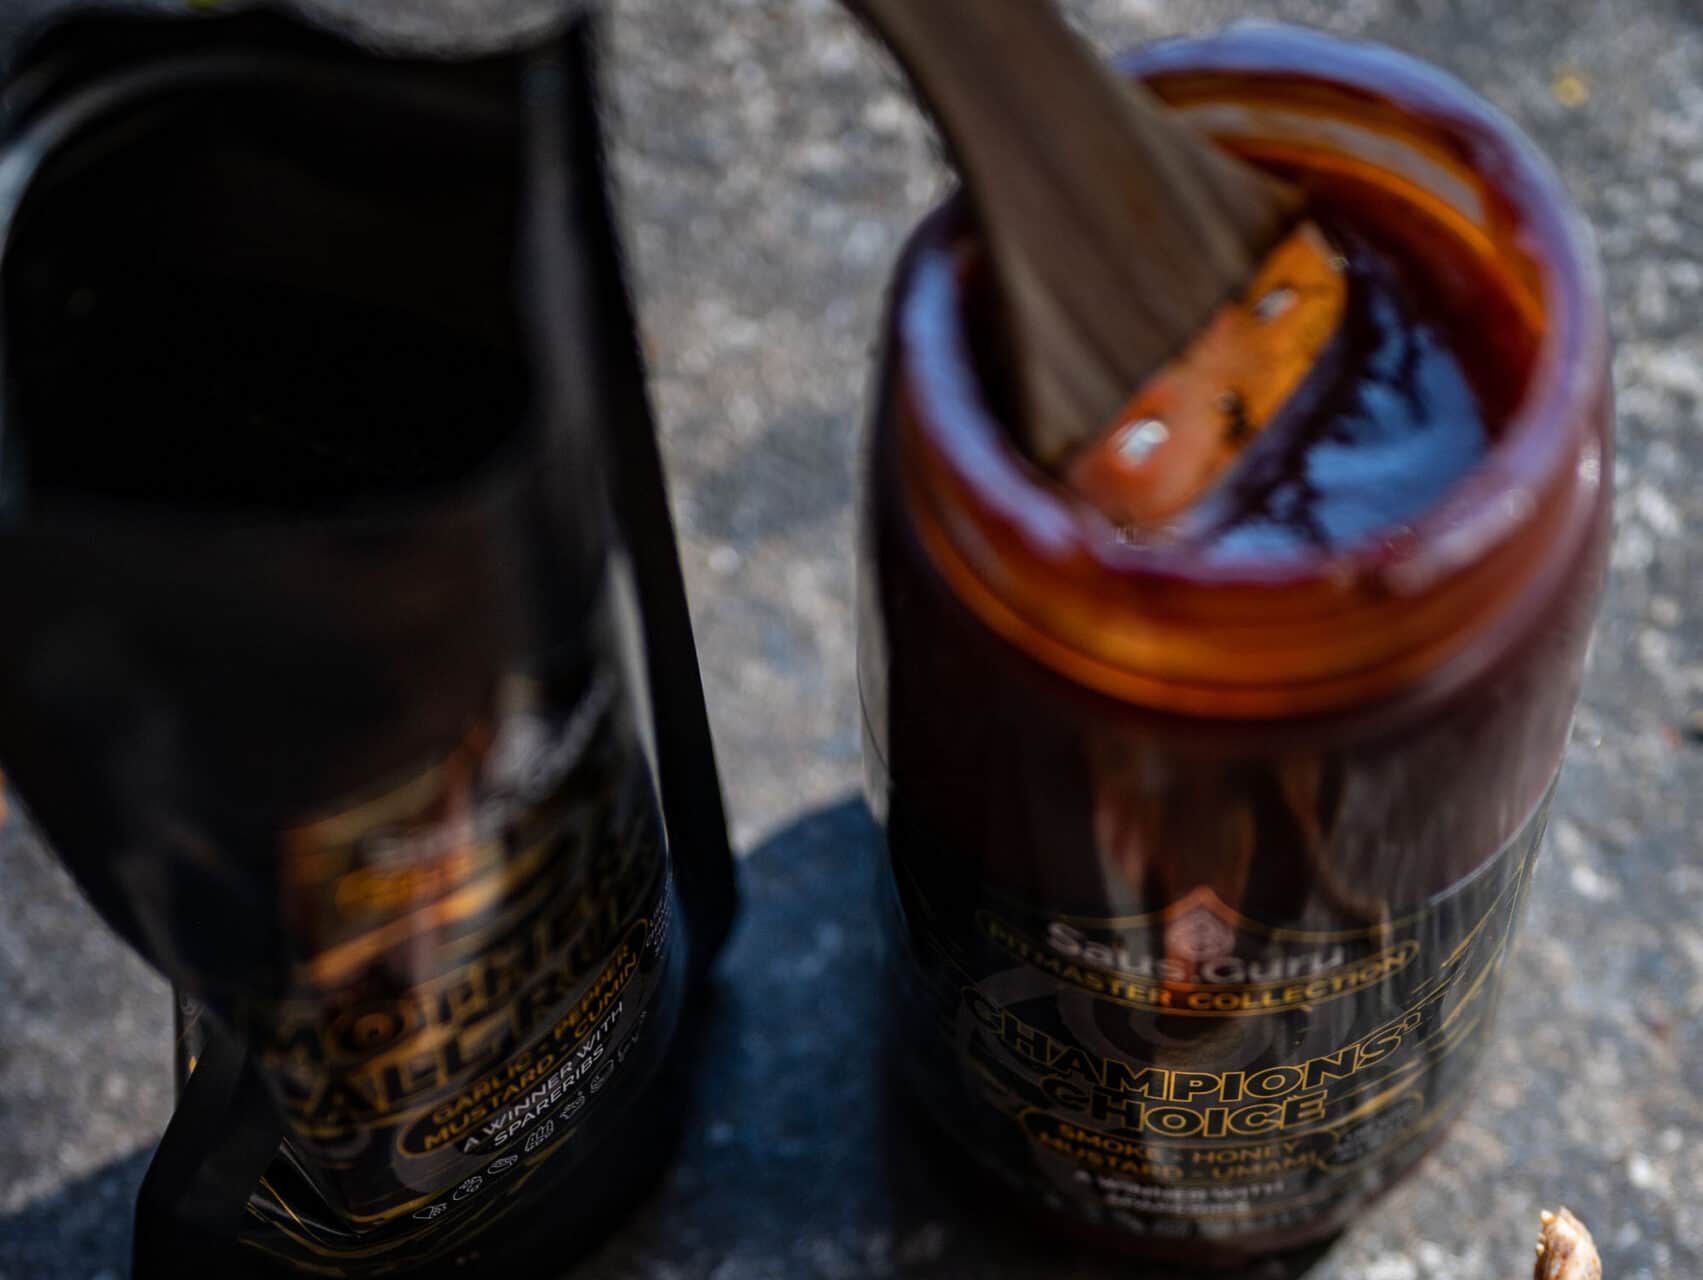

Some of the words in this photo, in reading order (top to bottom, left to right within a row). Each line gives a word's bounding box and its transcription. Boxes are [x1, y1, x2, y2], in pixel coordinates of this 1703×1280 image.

[1048, 920, 1346, 986] Saus.Guru
[1188, 951, 1411, 1011] COLLECTION
[422, 1053, 557, 1152] MUSTARD
[573, 951, 638, 1039] CUMIN
[432, 1050, 533, 1125] GARLIC
[552, 942, 632, 1040] PEPPER
[463, 1135, 482, 1154] A
[483, 1060, 573, 1136] WINNER
[576, 1000, 623, 1060] WITH
[960, 985, 1423, 1101] CHAMPIONS'
[493, 1043, 605, 1147] SPARERIBS
[1040, 1072, 1328, 1138] CHOICE
[1058, 1121, 1164, 1163] SMOKE
[1190, 1140, 1301, 1166] HONEY
